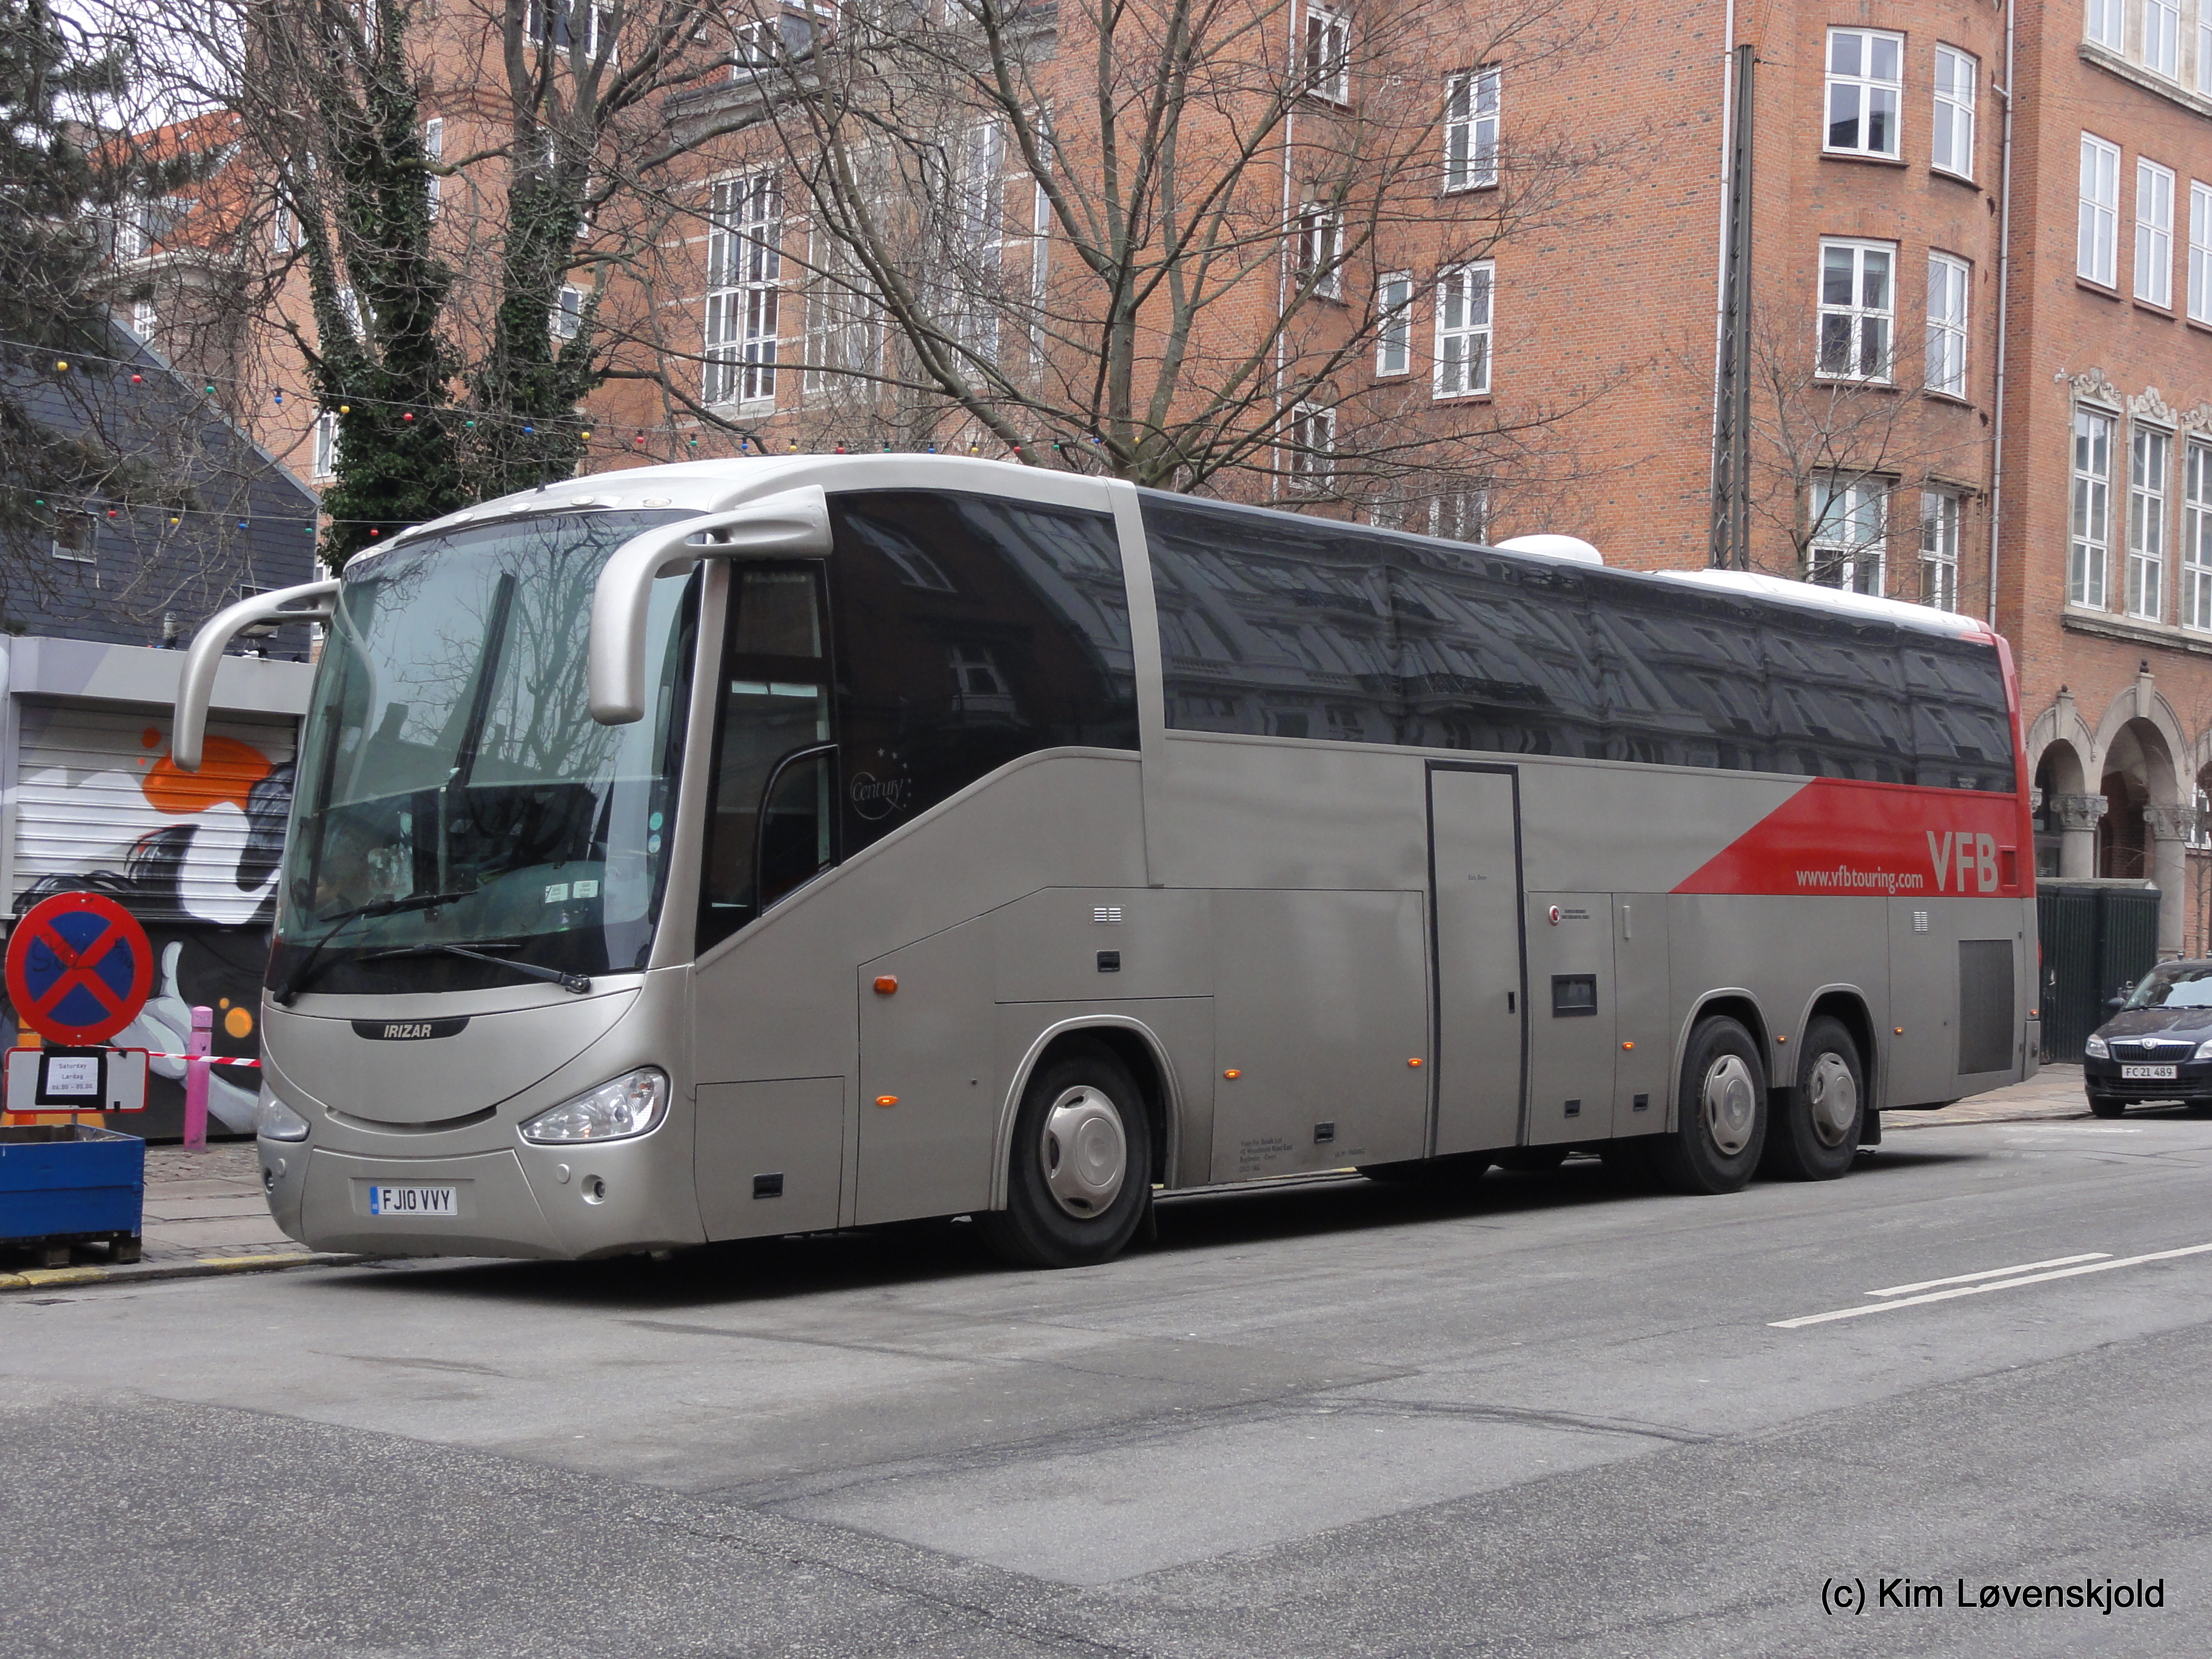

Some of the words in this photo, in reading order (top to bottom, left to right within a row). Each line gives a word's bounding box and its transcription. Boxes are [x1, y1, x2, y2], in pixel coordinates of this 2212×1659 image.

[851, 778, 903, 806] Century
[1926, 831, 1999, 893] VFB
[1796, 865, 1923, 894] www.vfbtouring.com
[384, 1024, 432, 1037] IRIZAR
[2126, 1067, 2138, 1076] FC
[2140, 1067, 2151, 1076] 21
[2154, 1067, 2172, 1076] 489
[383, 1190, 417, 1210] FJ10
[421, 1190, 449, 1210] VVY
